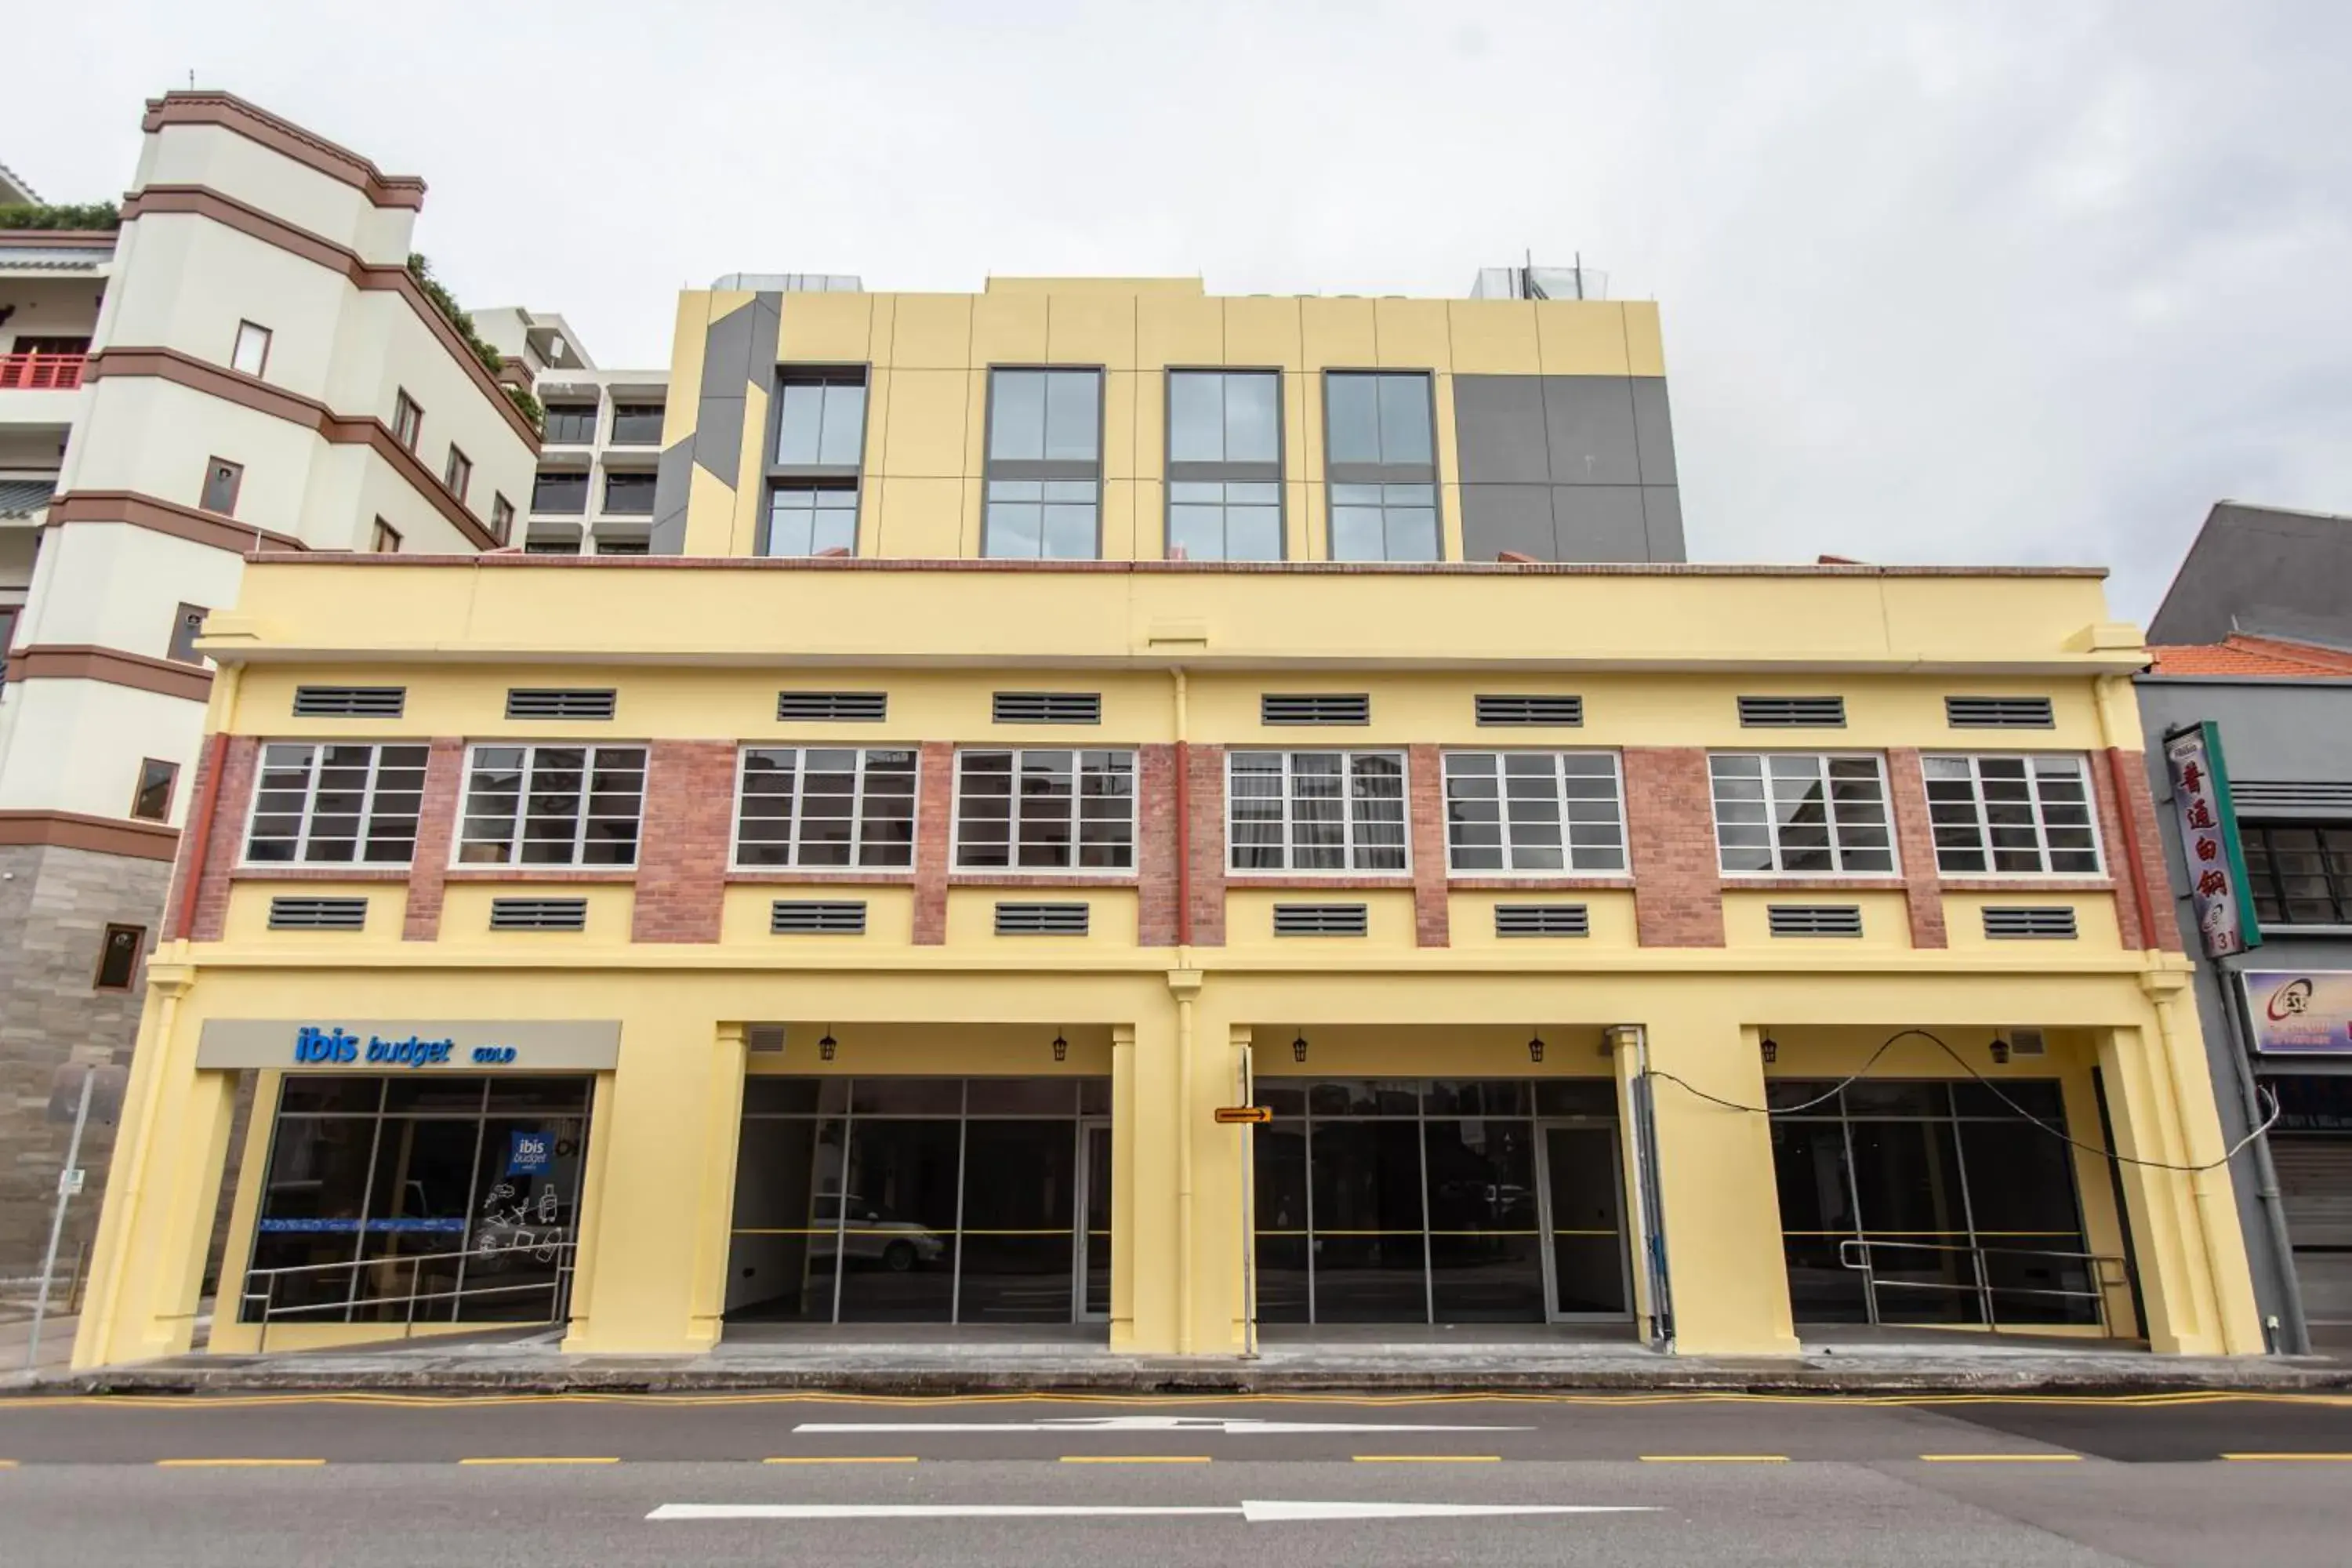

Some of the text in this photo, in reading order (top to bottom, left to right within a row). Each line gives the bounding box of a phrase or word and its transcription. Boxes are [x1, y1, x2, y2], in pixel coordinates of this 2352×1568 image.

[295, 1027, 518, 1068] ibis budget GOLD
[519, 1138, 546, 1154] ibis
[514, 1152, 547, 1166] budget
